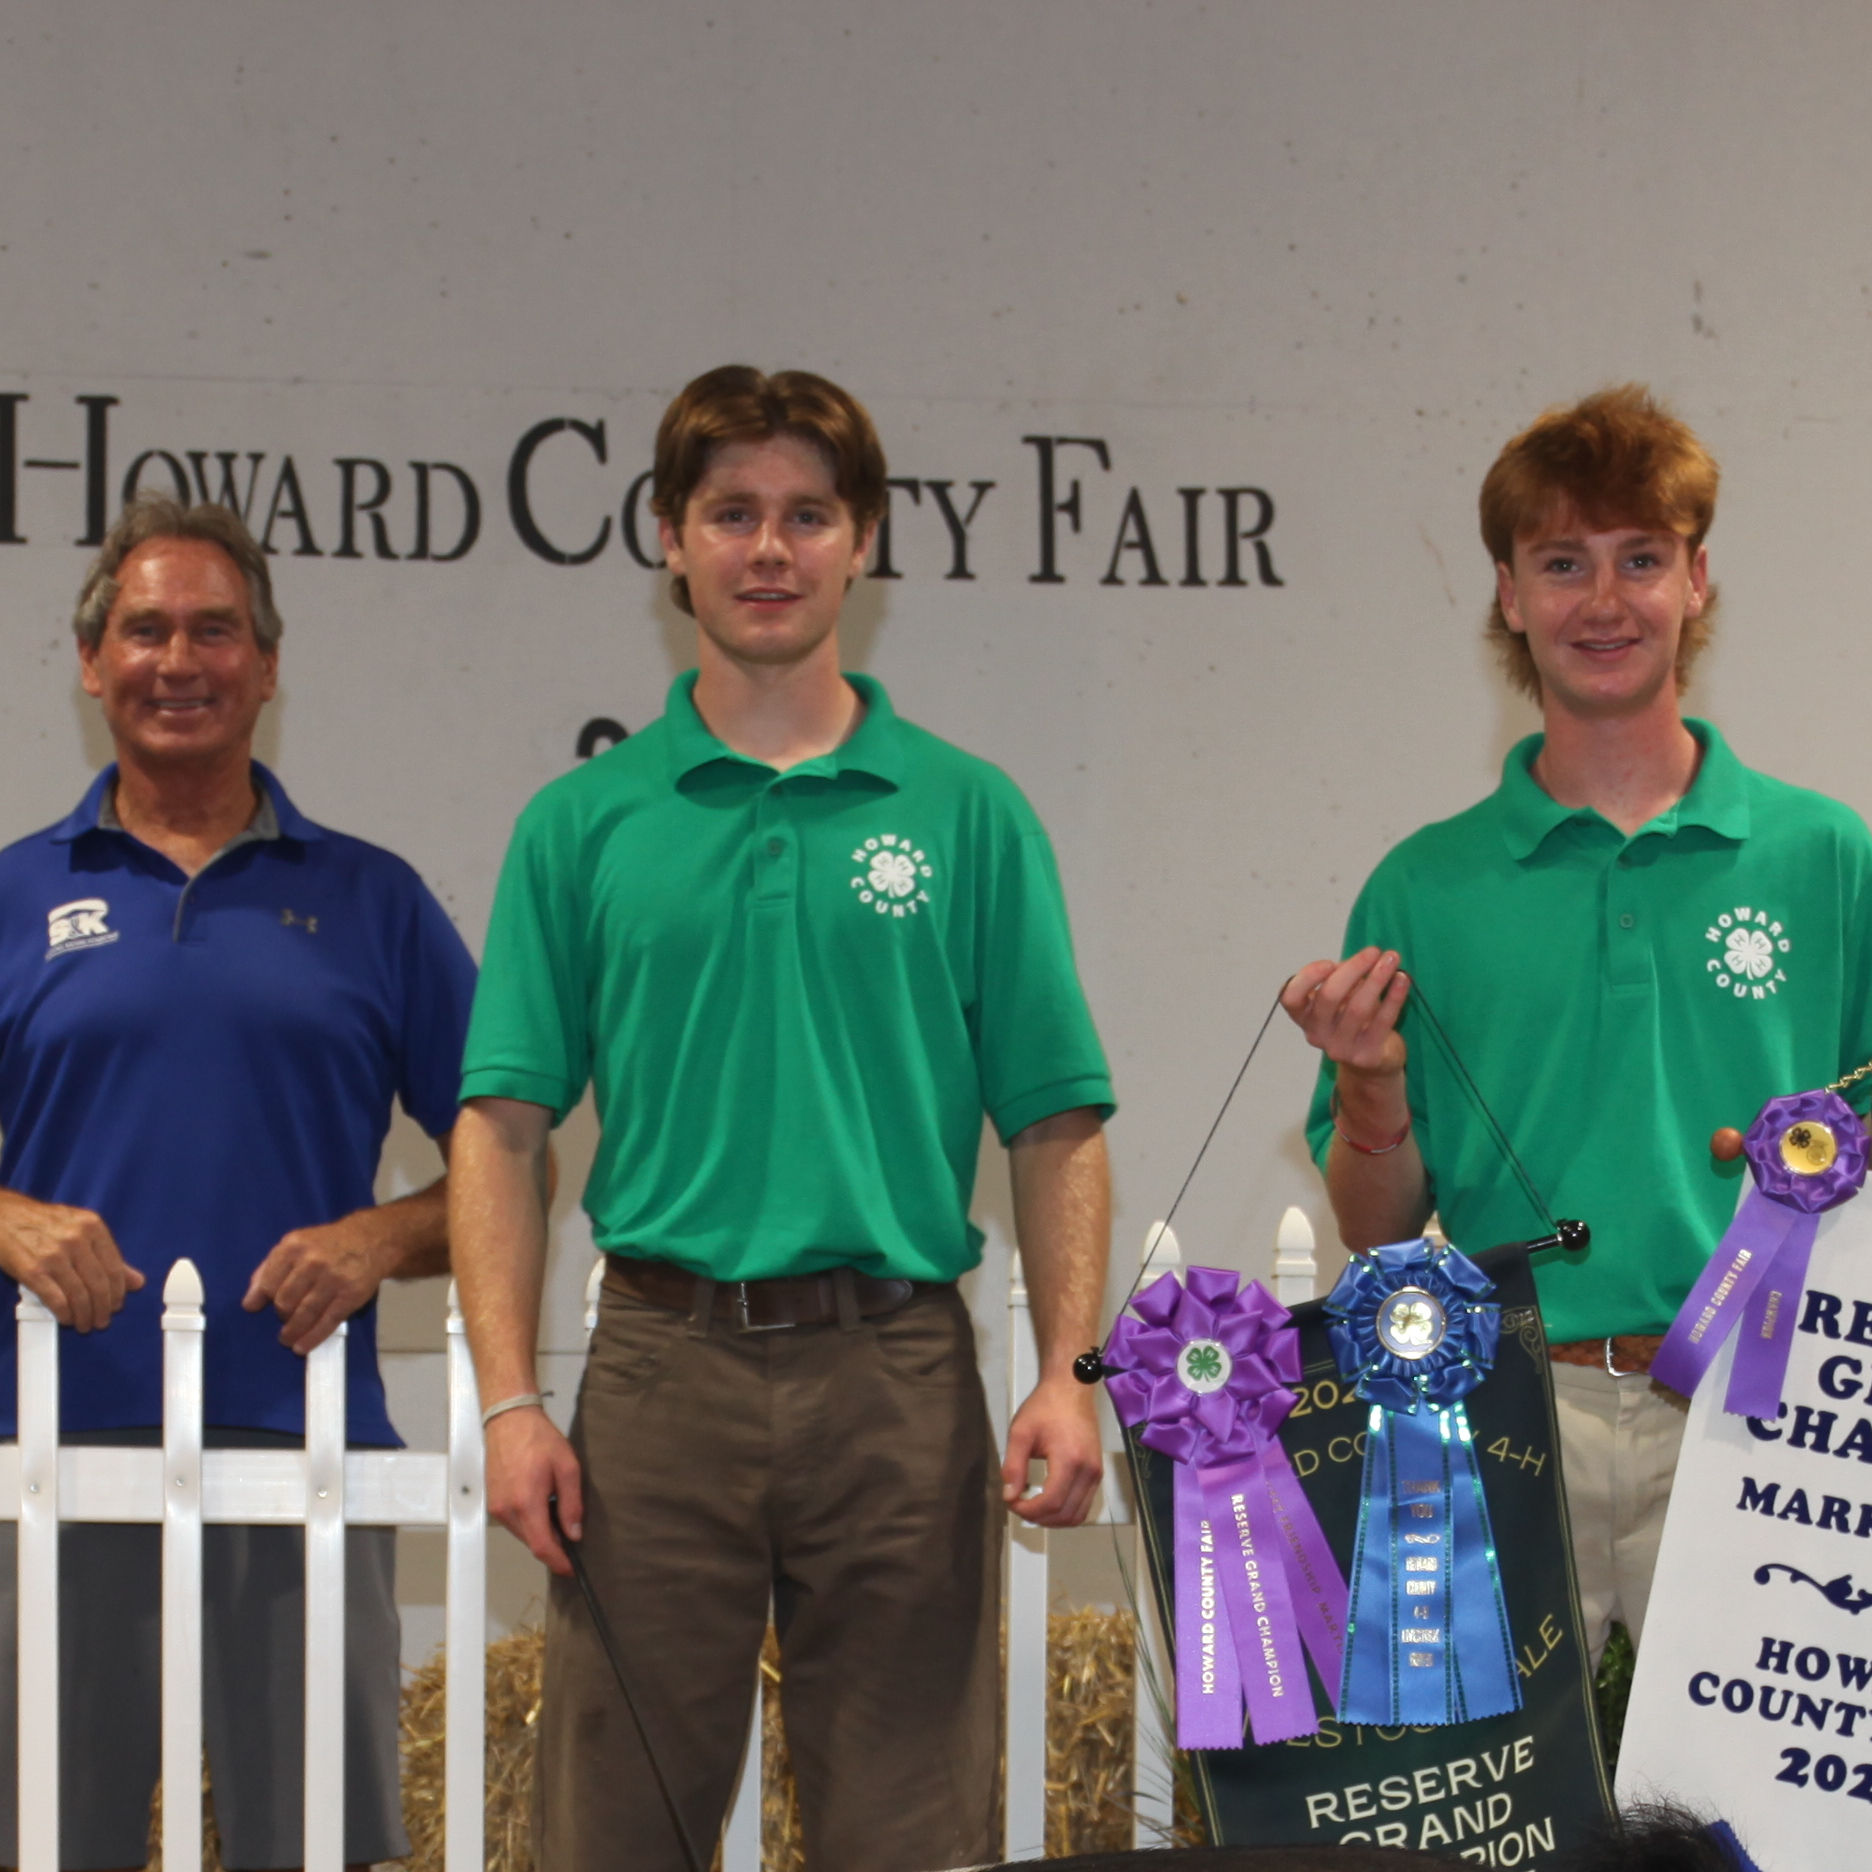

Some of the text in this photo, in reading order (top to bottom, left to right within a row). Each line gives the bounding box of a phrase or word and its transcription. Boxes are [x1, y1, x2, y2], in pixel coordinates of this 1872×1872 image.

[506, 416, 997, 581] COTY
[1020, 434, 1286, 588] FAIR
[850, 834, 933, 878] HOWARD
[850, 876, 931, 918] COUNTY
[1704, 906, 1791, 953] HOWARD
[1706, 958, 1788, 1000] COUNTY
[1710, 1269, 1738, 1307] COUNTY
[1731, 1248, 1753, 1272] FAIR
[1486, 1435, 1547, 1478] 4-H
[1200, 1520, 1215, 1694] HOWARD COUNTY FAIR
[1231, 1493, 1284, 1698] RESERVE GRAND CHAMPION
[1305, 1735, 1536, 1829] RESERVE
